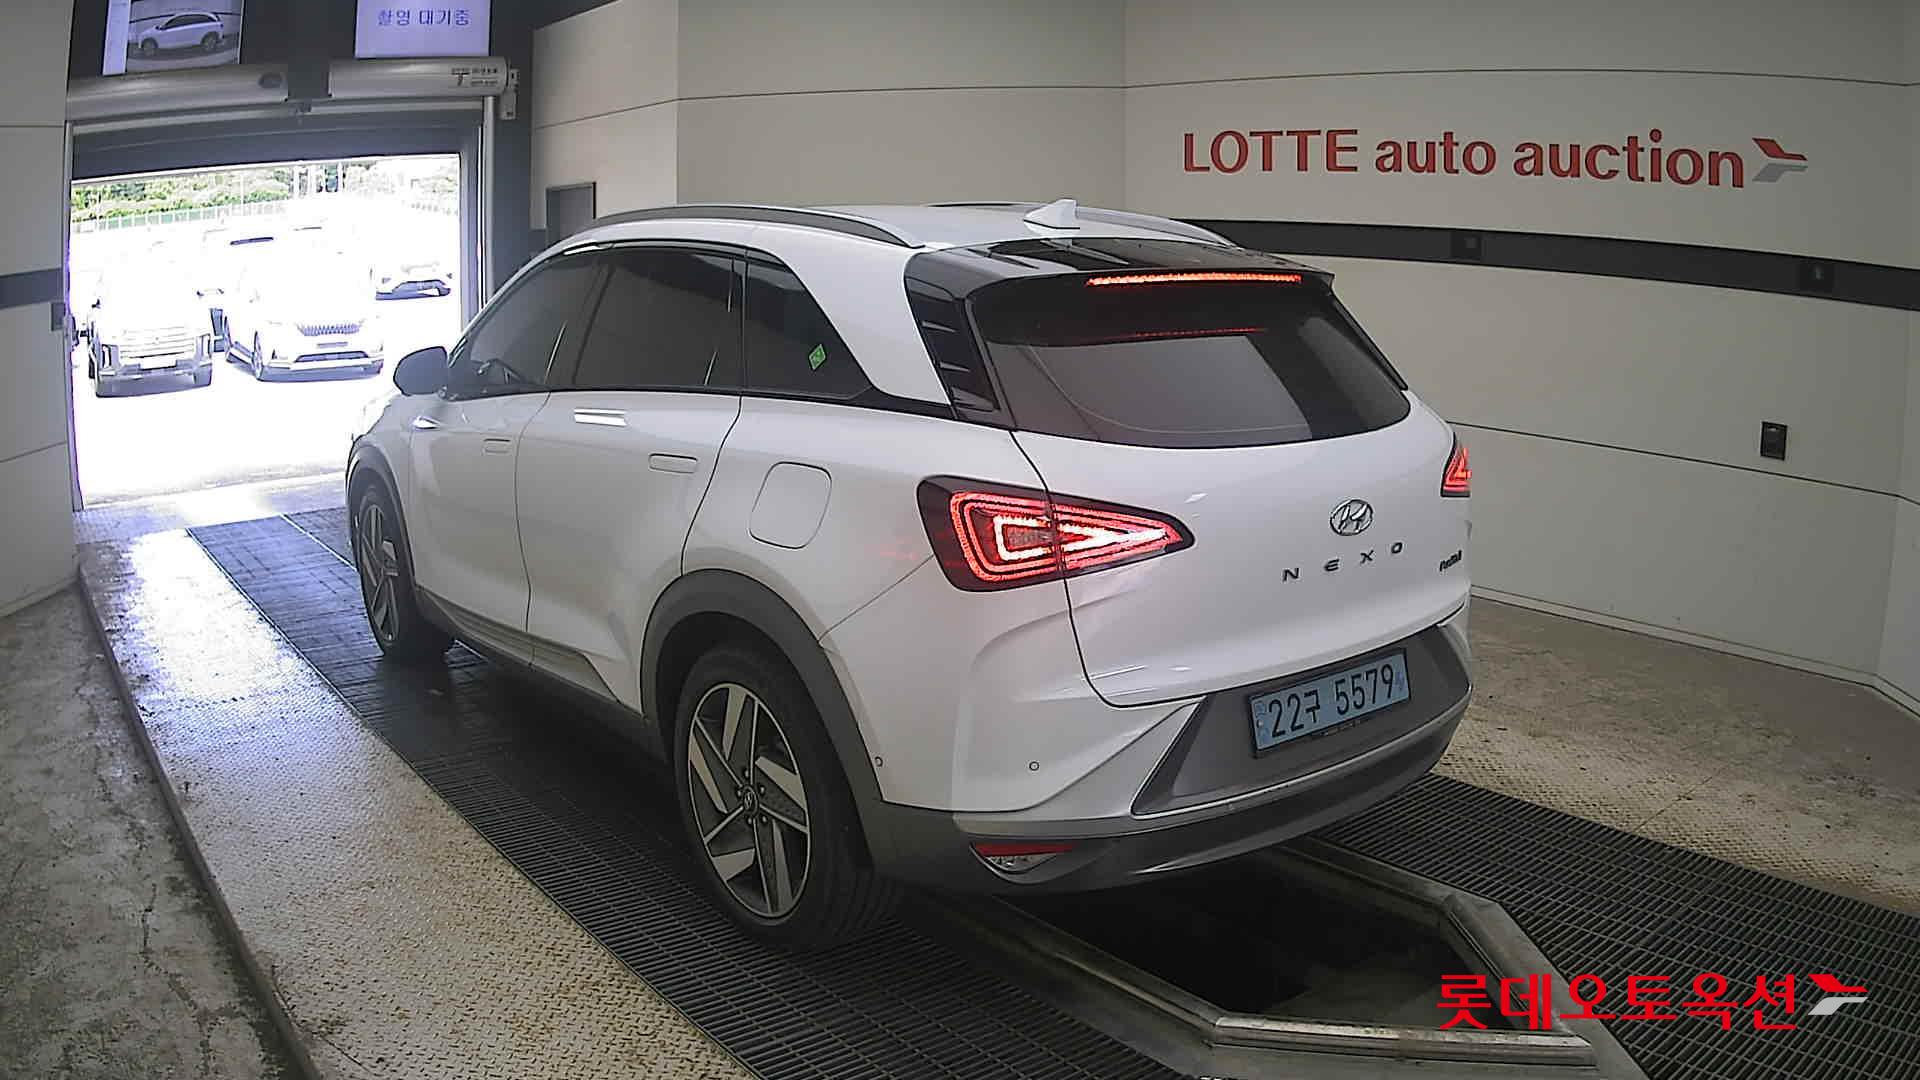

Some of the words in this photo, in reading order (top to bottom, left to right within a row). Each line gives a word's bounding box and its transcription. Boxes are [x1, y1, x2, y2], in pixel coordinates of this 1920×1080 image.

[419, 9, 469, 26] 대기중
[1182, 129, 1359, 174] LOTTE
[1374, 131, 1497, 176] auto
[1512, 129, 1745, 189] auction
[1282, 541, 1404, 583] NEXO
[1268, 689, 1321, 738] 22구
[1334, 663, 1394, 716] 5579
